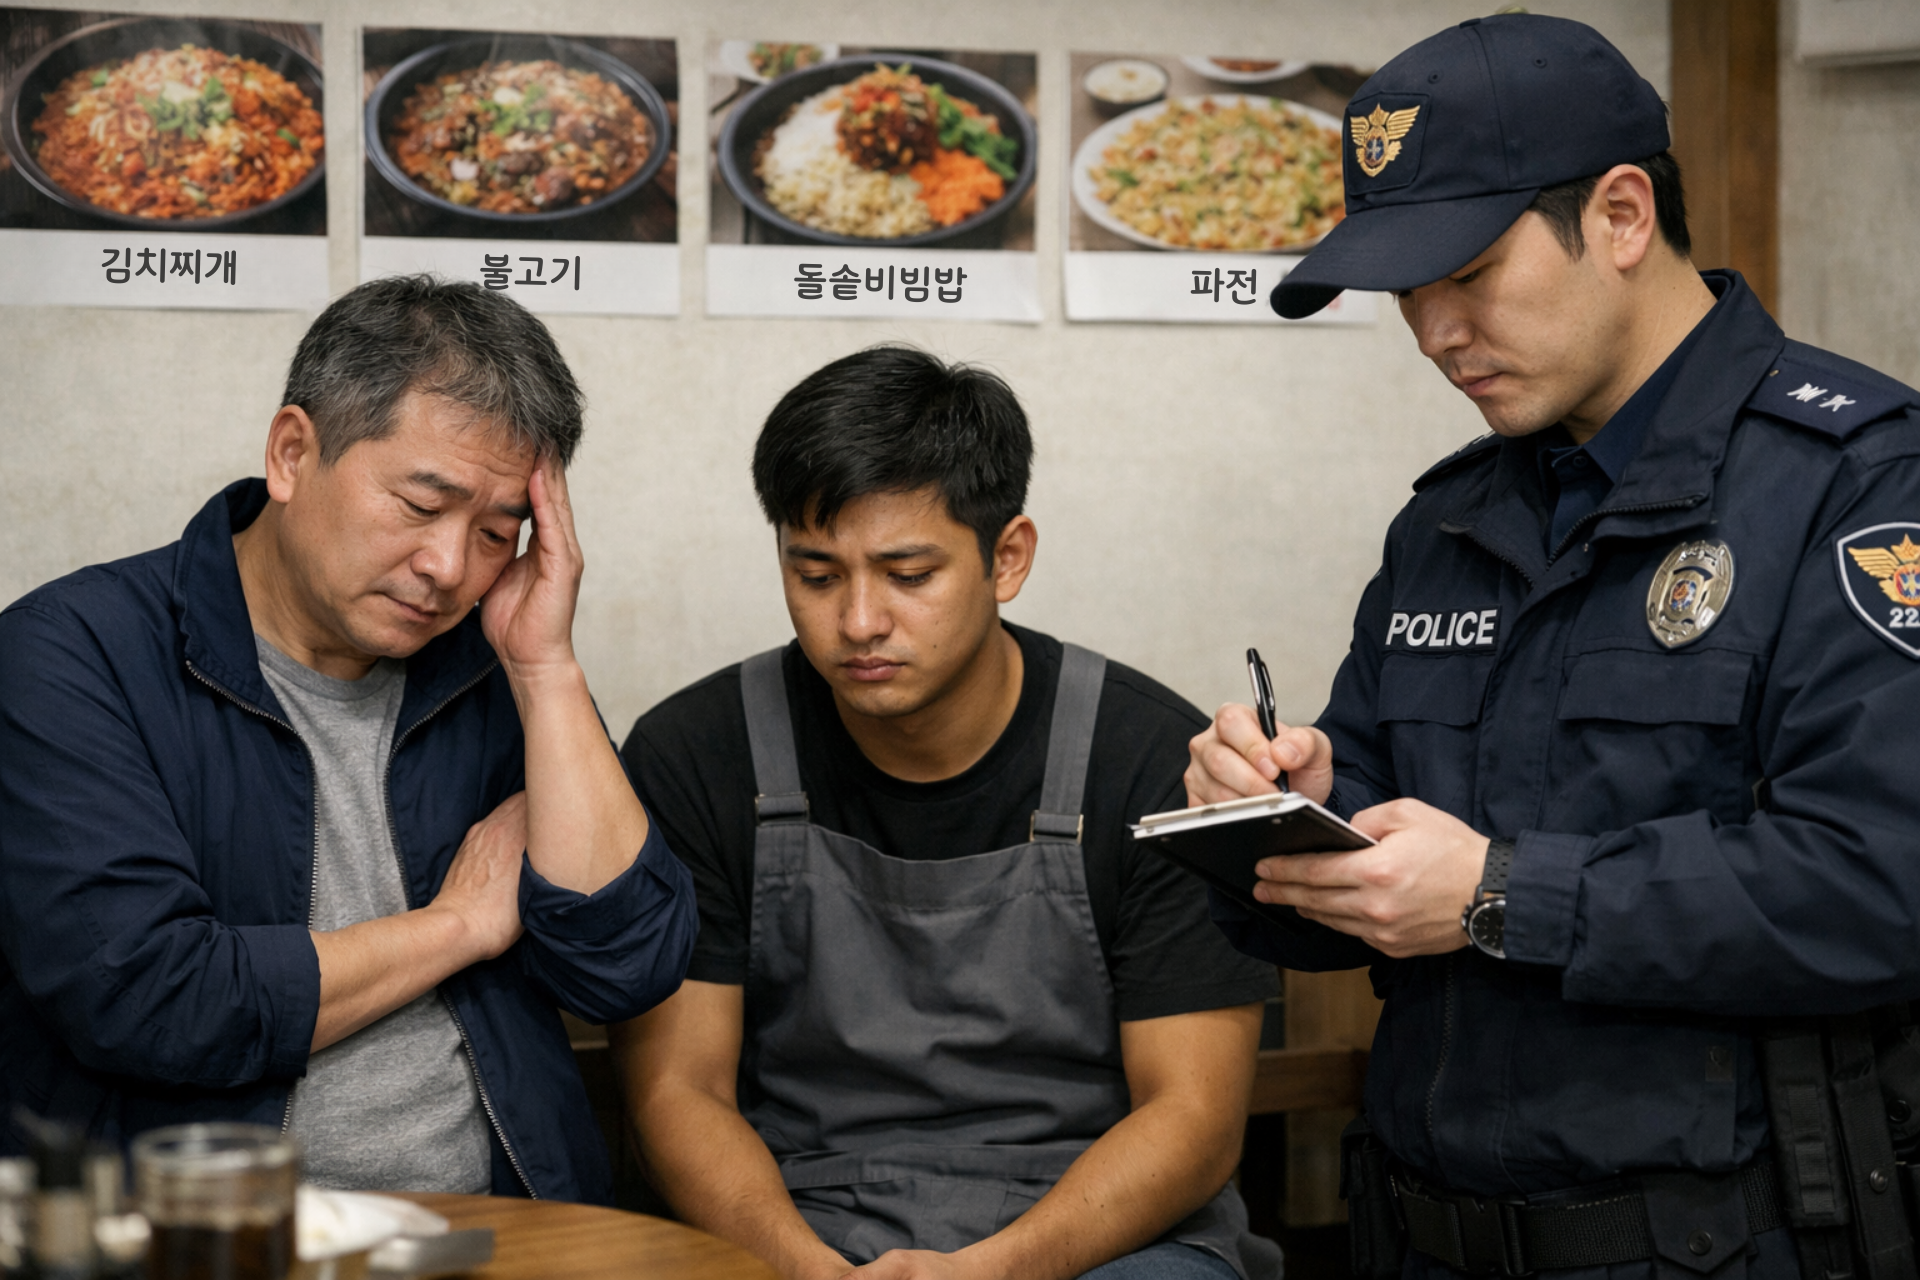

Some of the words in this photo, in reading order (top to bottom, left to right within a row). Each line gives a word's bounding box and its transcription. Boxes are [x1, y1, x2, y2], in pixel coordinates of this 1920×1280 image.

[101, 248, 237, 285] 김치찌개
[480, 253, 580, 291] 불고기
[794, 263, 968, 304] 돌솥비빔밥
[1190, 267, 1257, 305] 파전
[1385, 609, 1498, 647] POLICE
